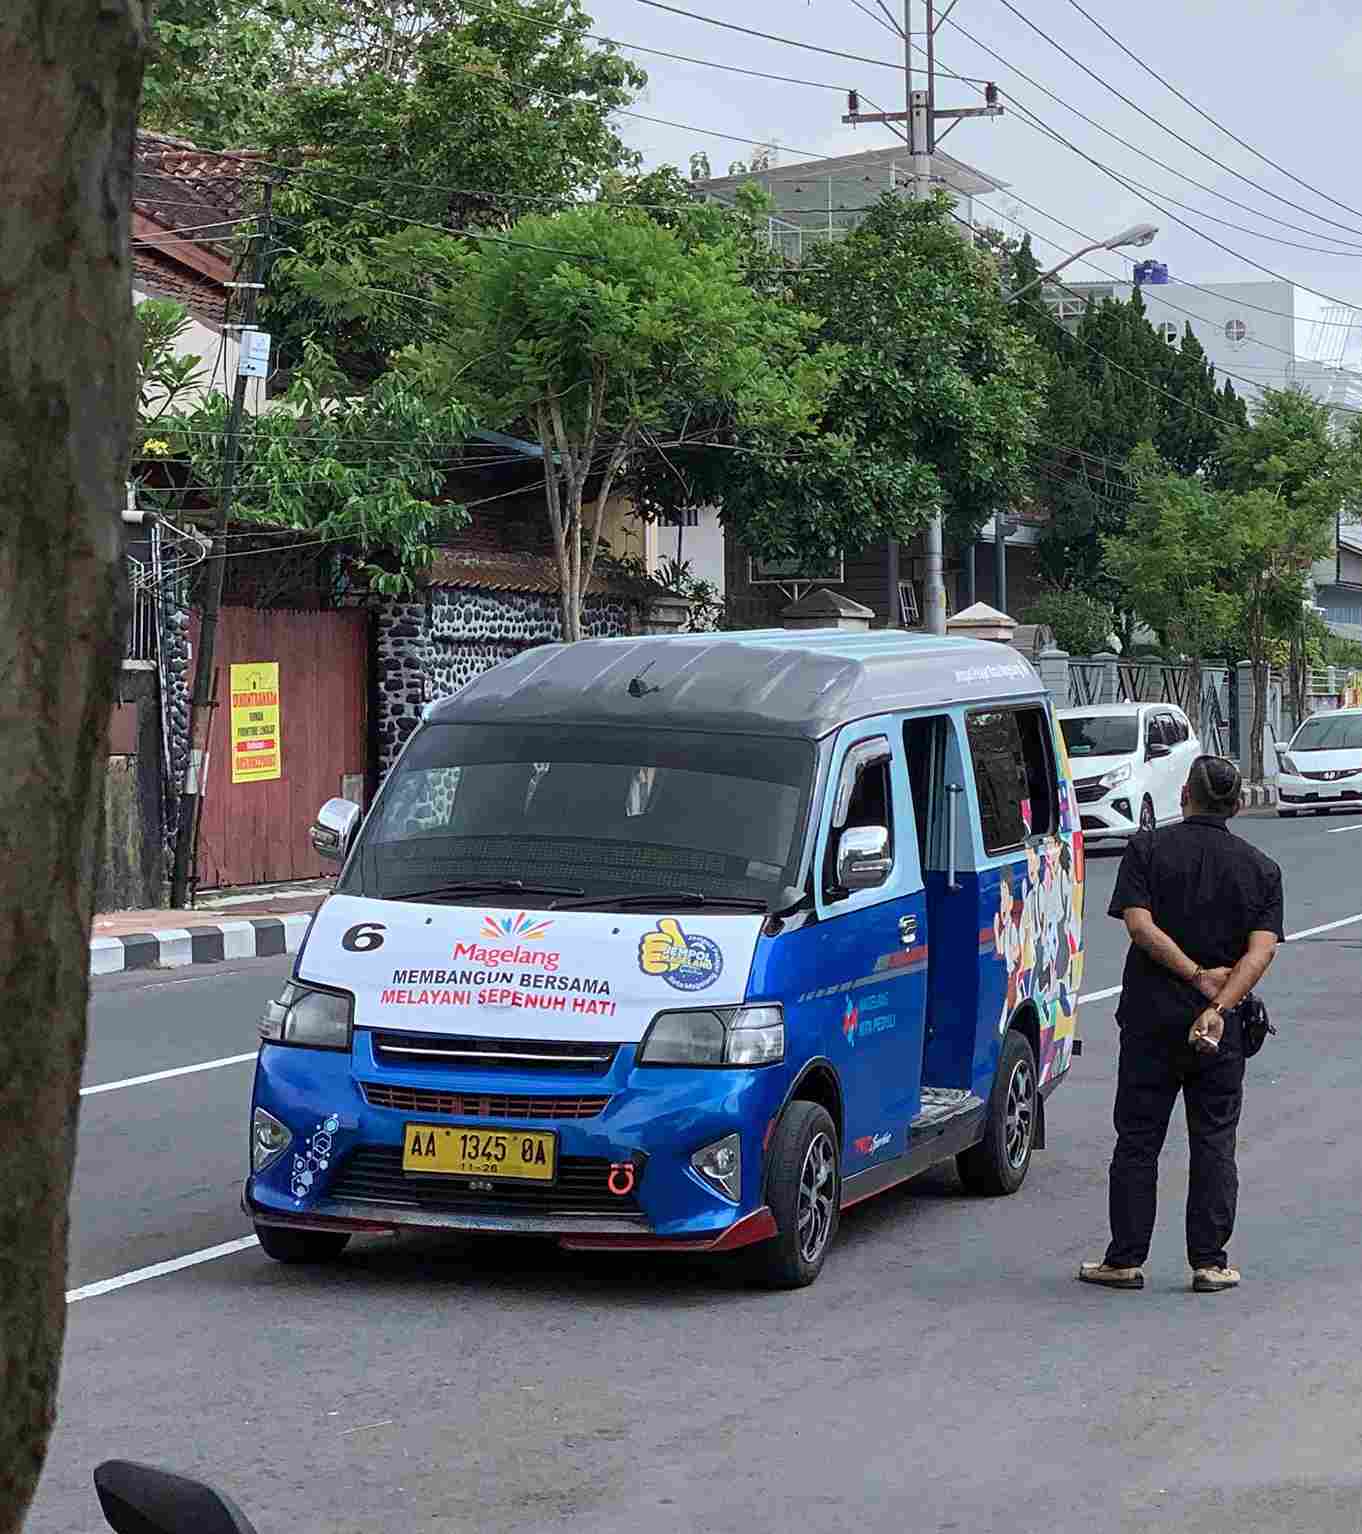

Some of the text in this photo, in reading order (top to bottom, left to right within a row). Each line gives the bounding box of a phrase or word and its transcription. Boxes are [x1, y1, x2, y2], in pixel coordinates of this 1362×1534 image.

[342, 922, 386, 952] 6
[453, 943, 560, 971] Magelang
[393, 969, 611, 995] MEMBANGUN BERSAMA
[381, 988, 616, 1017] MELAYANI SEPENUH HATI
[411, 1131, 437, 1157] AA
[460, 1134, 508, 1162] 1345
